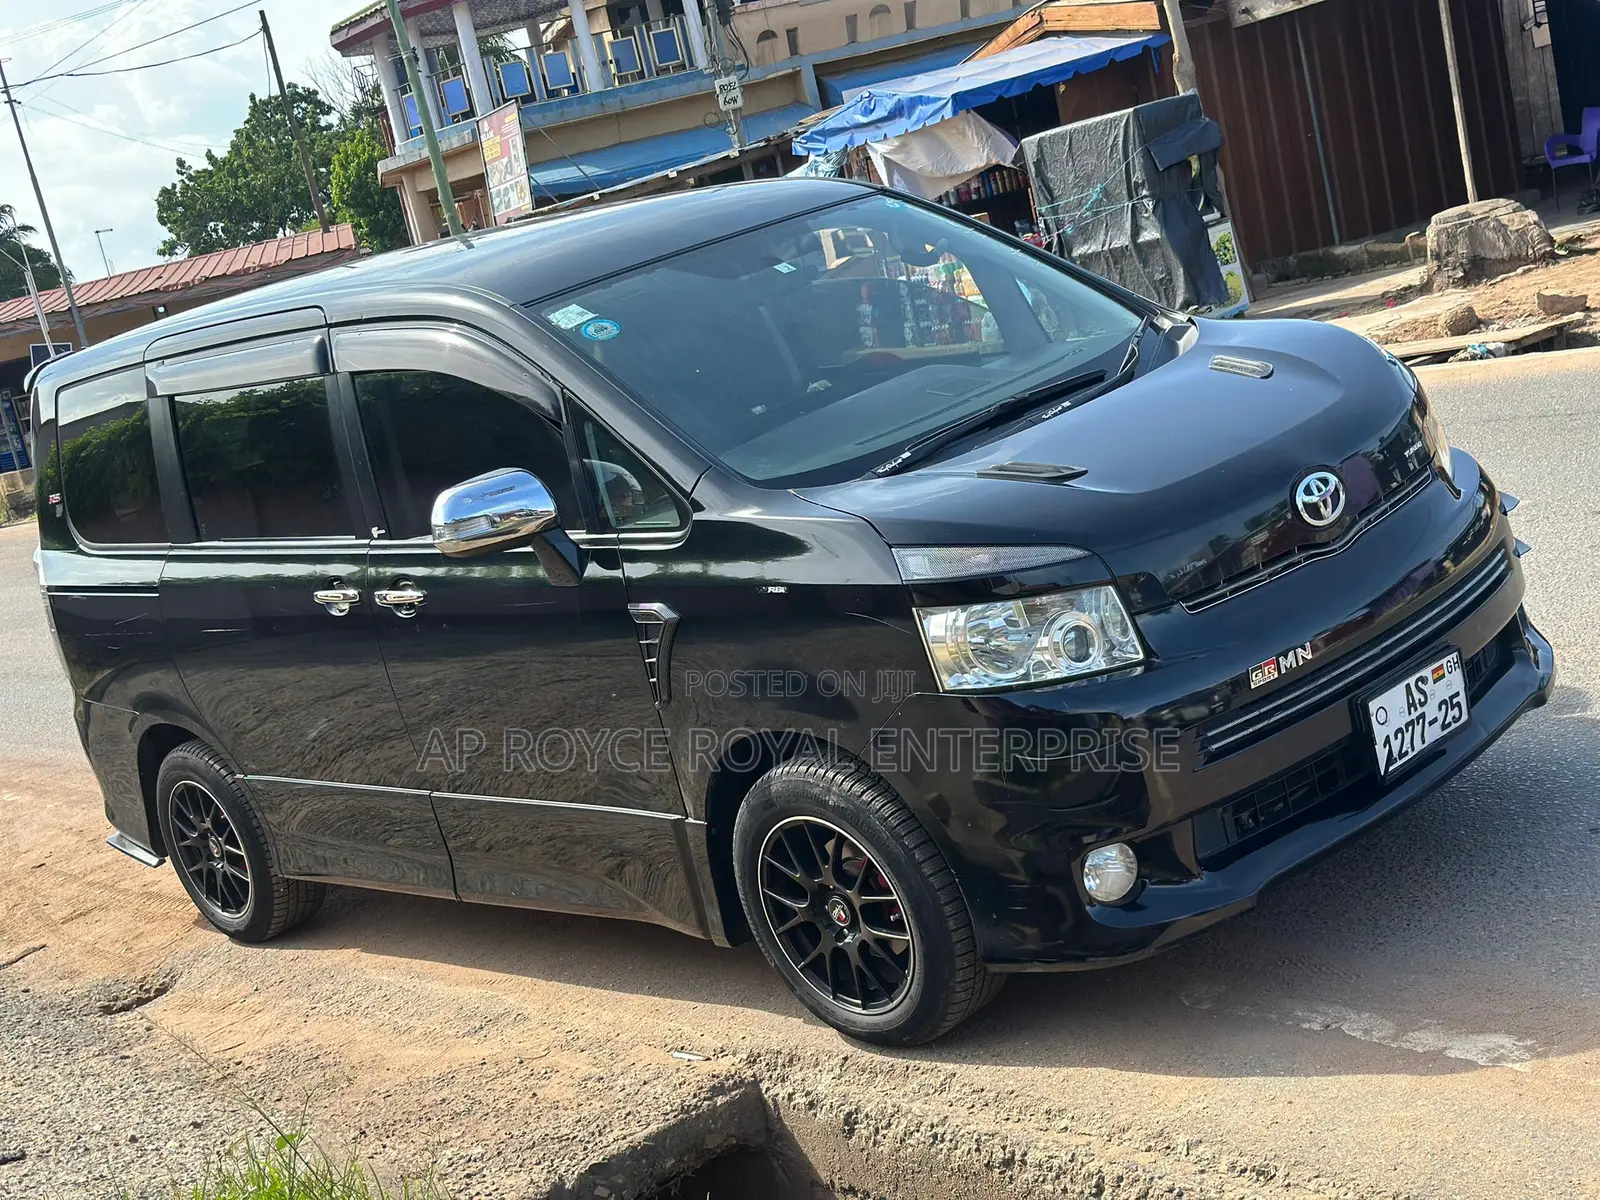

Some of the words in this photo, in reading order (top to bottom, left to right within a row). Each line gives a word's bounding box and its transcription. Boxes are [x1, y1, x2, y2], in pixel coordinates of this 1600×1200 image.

[1252, 663, 1276, 682] GR
[1278, 641, 1313, 675] MN
[1252, 673, 1276, 687] SPORT
[1446, 655, 1461, 675] GH
[1404, 675, 1429, 716] AS
[1382, 691, 1463, 766] 1277-25
